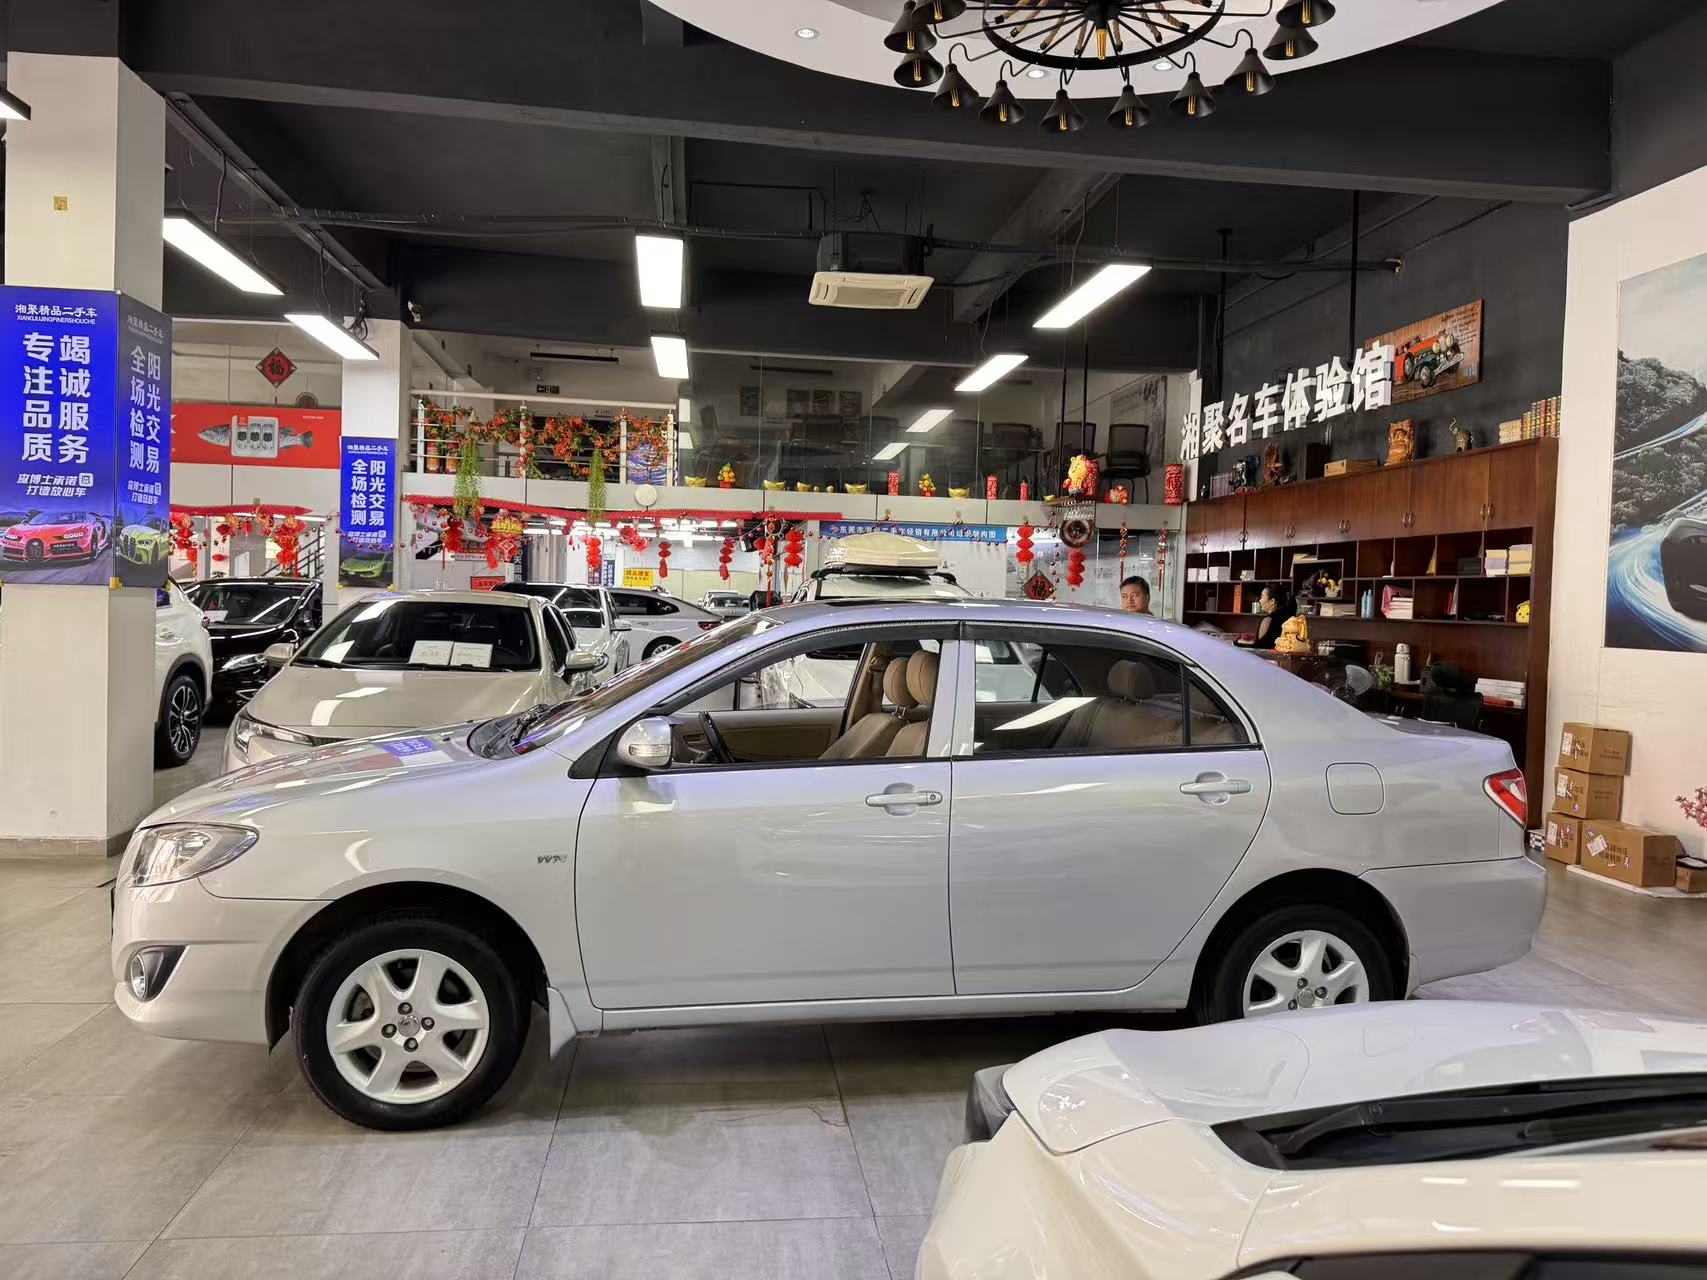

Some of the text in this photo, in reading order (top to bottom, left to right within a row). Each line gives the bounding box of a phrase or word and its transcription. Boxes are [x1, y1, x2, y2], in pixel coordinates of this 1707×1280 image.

[15, 304, 98, 318] 湘聚精品二手车
[22, 332, 55, 463] 专注品质
[58, 334, 91, 464] 竭诚服务
[129, 345, 146, 471] 全场检测
[146, 351, 161, 474] 阳光交易
[1180, 340, 1395, 460] 湘聚名车体验馆
[350, 458, 368, 526] 全场检测
[368, 460, 386, 526] 阳光交易
